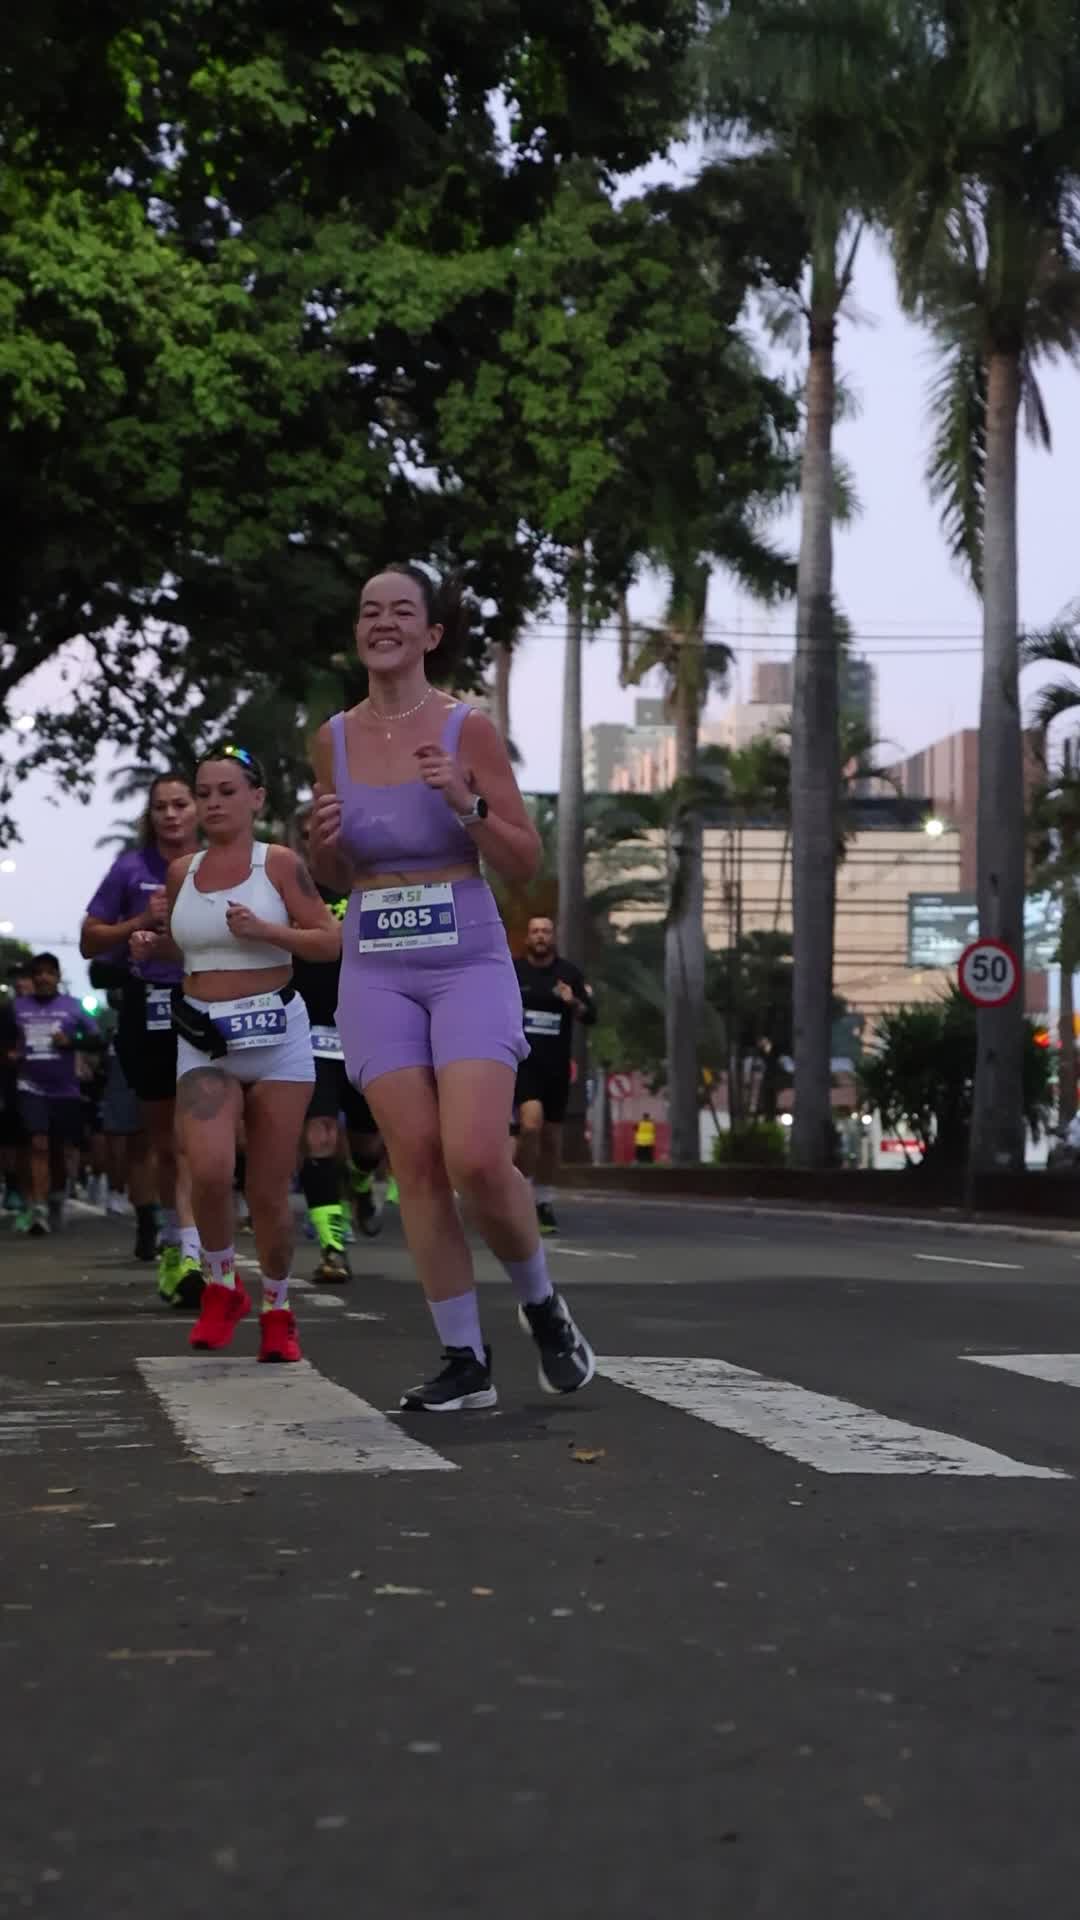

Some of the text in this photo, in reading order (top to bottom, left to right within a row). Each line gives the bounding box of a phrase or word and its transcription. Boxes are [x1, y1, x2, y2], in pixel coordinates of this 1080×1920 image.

[377, 908, 432, 930] 6085
[971, 955, 1007, 983] 50
[231, 1012, 277, 1032] 5142
